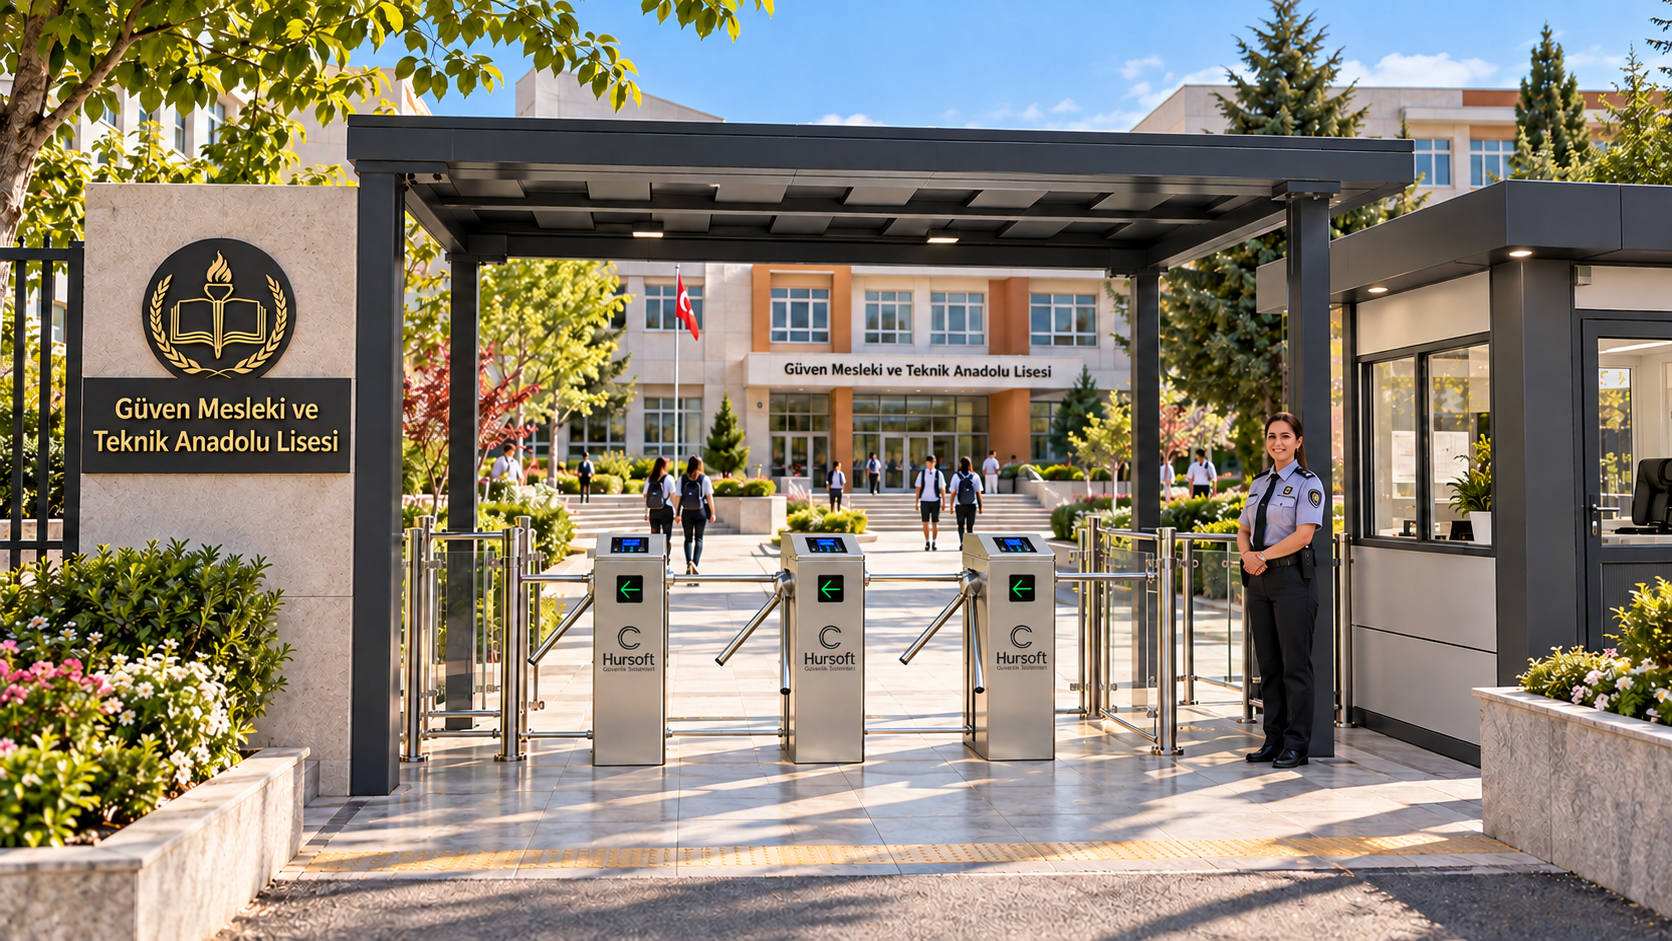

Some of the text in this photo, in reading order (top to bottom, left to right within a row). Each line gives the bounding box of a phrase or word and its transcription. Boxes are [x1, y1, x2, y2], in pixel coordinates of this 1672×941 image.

[785, 362, 1052, 378] Güven Mesleki ve Teknik Anadolu Lisesi
[115, 397, 319, 420] Güven Mesleki ve
[93, 429, 339, 453] Teknik Anadolu Lisesi
[602, 652, 655, 666] Hursoft
[804, 651, 856, 665] Hursoft
[996, 650, 1048, 664] Hursoft
